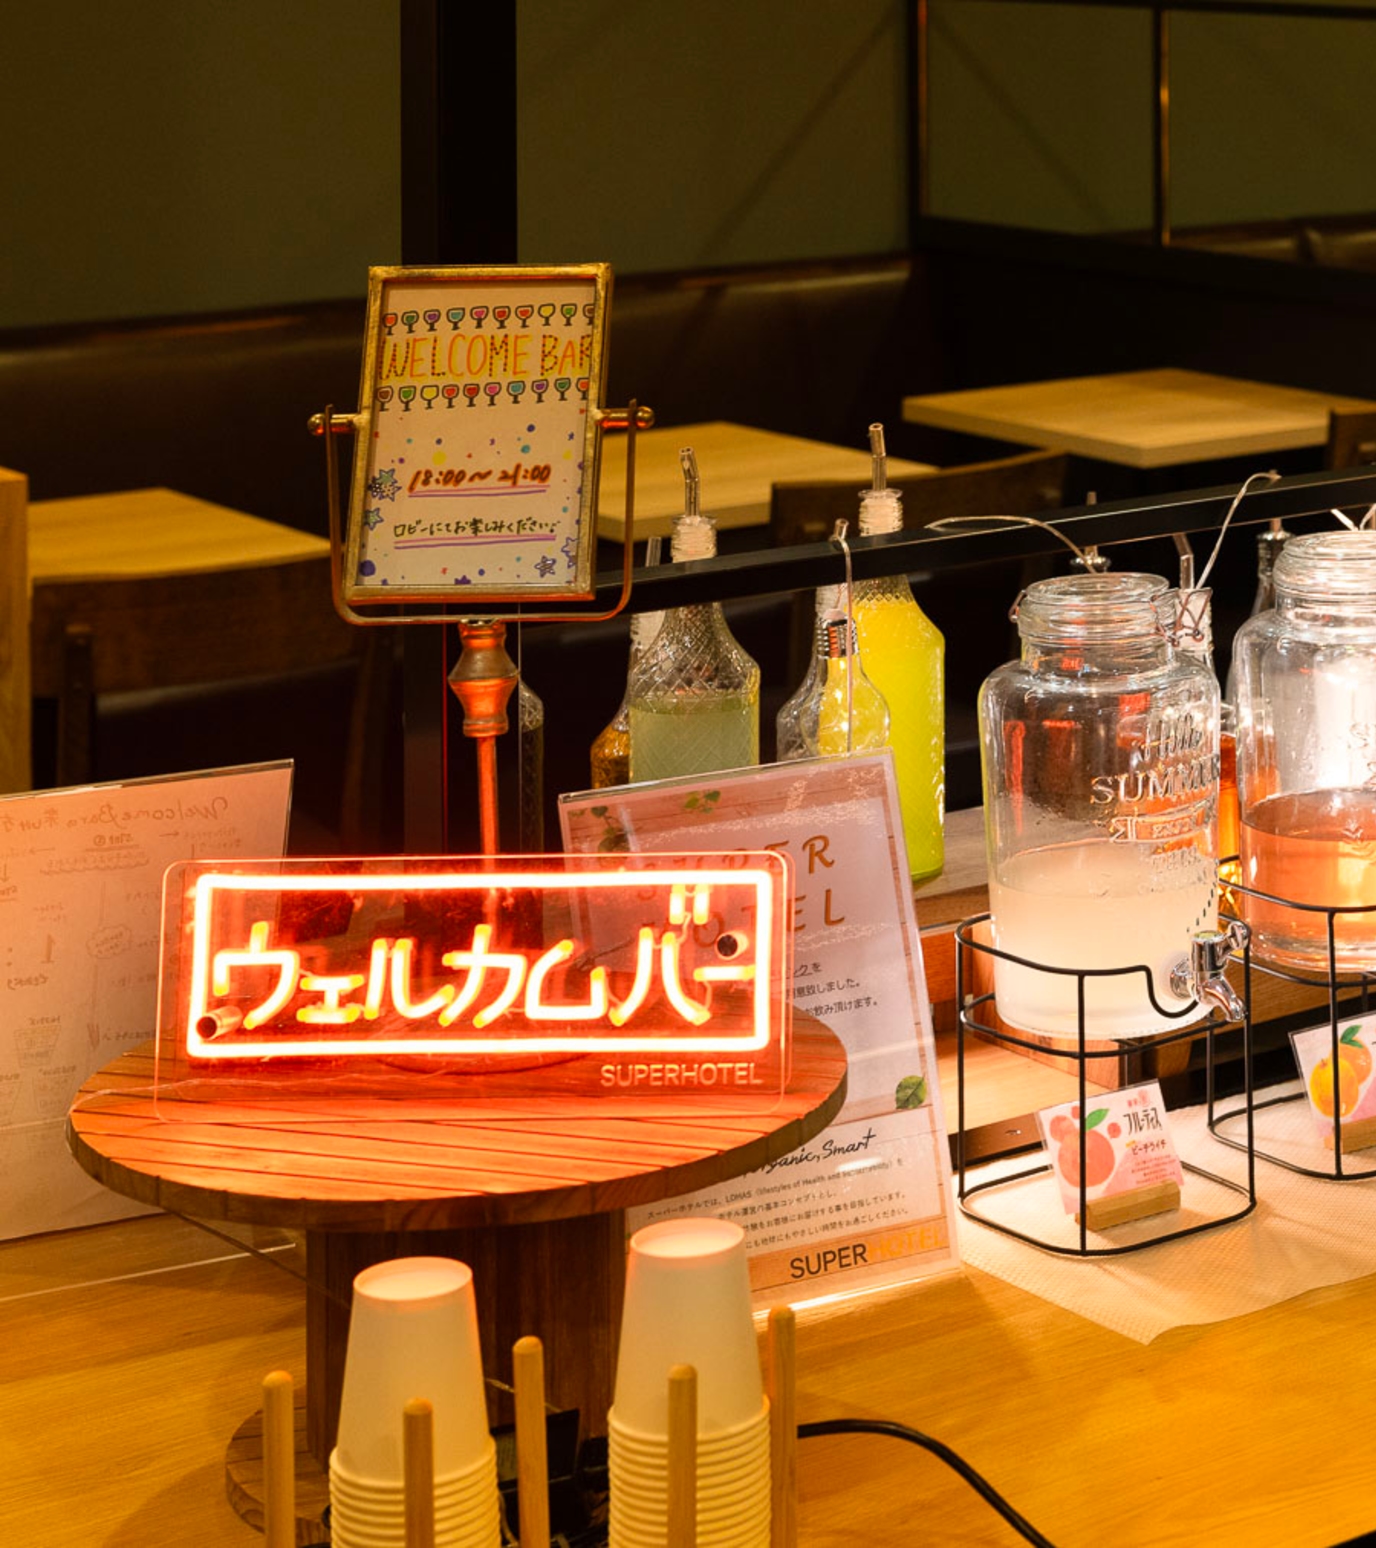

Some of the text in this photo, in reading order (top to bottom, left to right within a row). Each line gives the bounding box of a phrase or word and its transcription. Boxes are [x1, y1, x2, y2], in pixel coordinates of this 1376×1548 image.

[379, 333, 530, 379] WELCOME
[213, 884, 755, 1029] ウェルカムバー
[600, 1062, 763, 1087] SUPERHOTEL
[790, 1243, 868, 1279] SUPER
